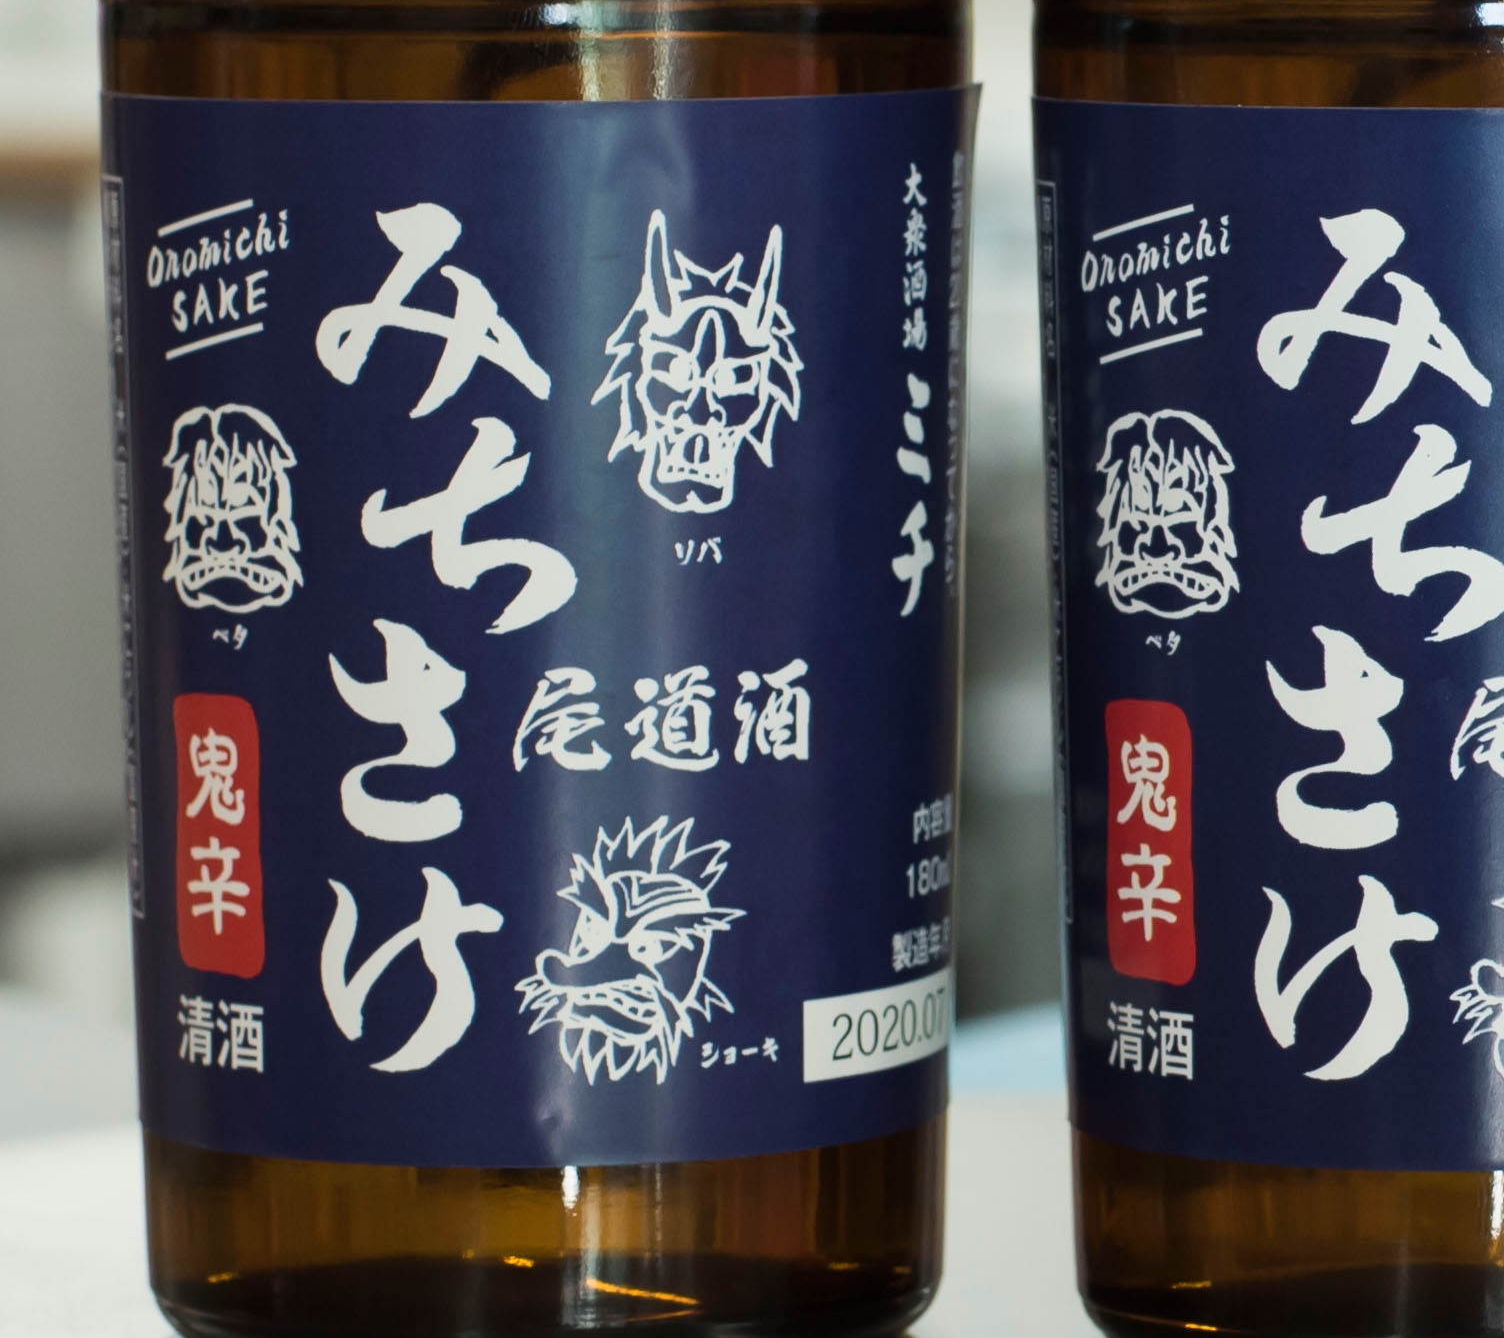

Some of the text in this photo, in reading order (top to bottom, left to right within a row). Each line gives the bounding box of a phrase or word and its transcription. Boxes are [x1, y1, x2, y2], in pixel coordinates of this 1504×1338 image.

[146, 209, 290, 288] Onomichi
[902, 162, 929, 351] 大衆酒場
[1081, 215, 1232, 293] Onomichi
[172, 269, 269, 333] SAKE
[1105, 275, 1208, 338] SAKE
[315, 202, 578, 1073] みちさけ
[512, 658, 811, 772] 尾道酒
[185, 727, 249, 936] 鬼辛
[1116, 732, 1181, 942] 鬼辛
[177, 993, 265, 1074] 清酒
[700, 1035, 780, 1070] ショーキ
[1106, 1000, 1195, 1081] 清酒
